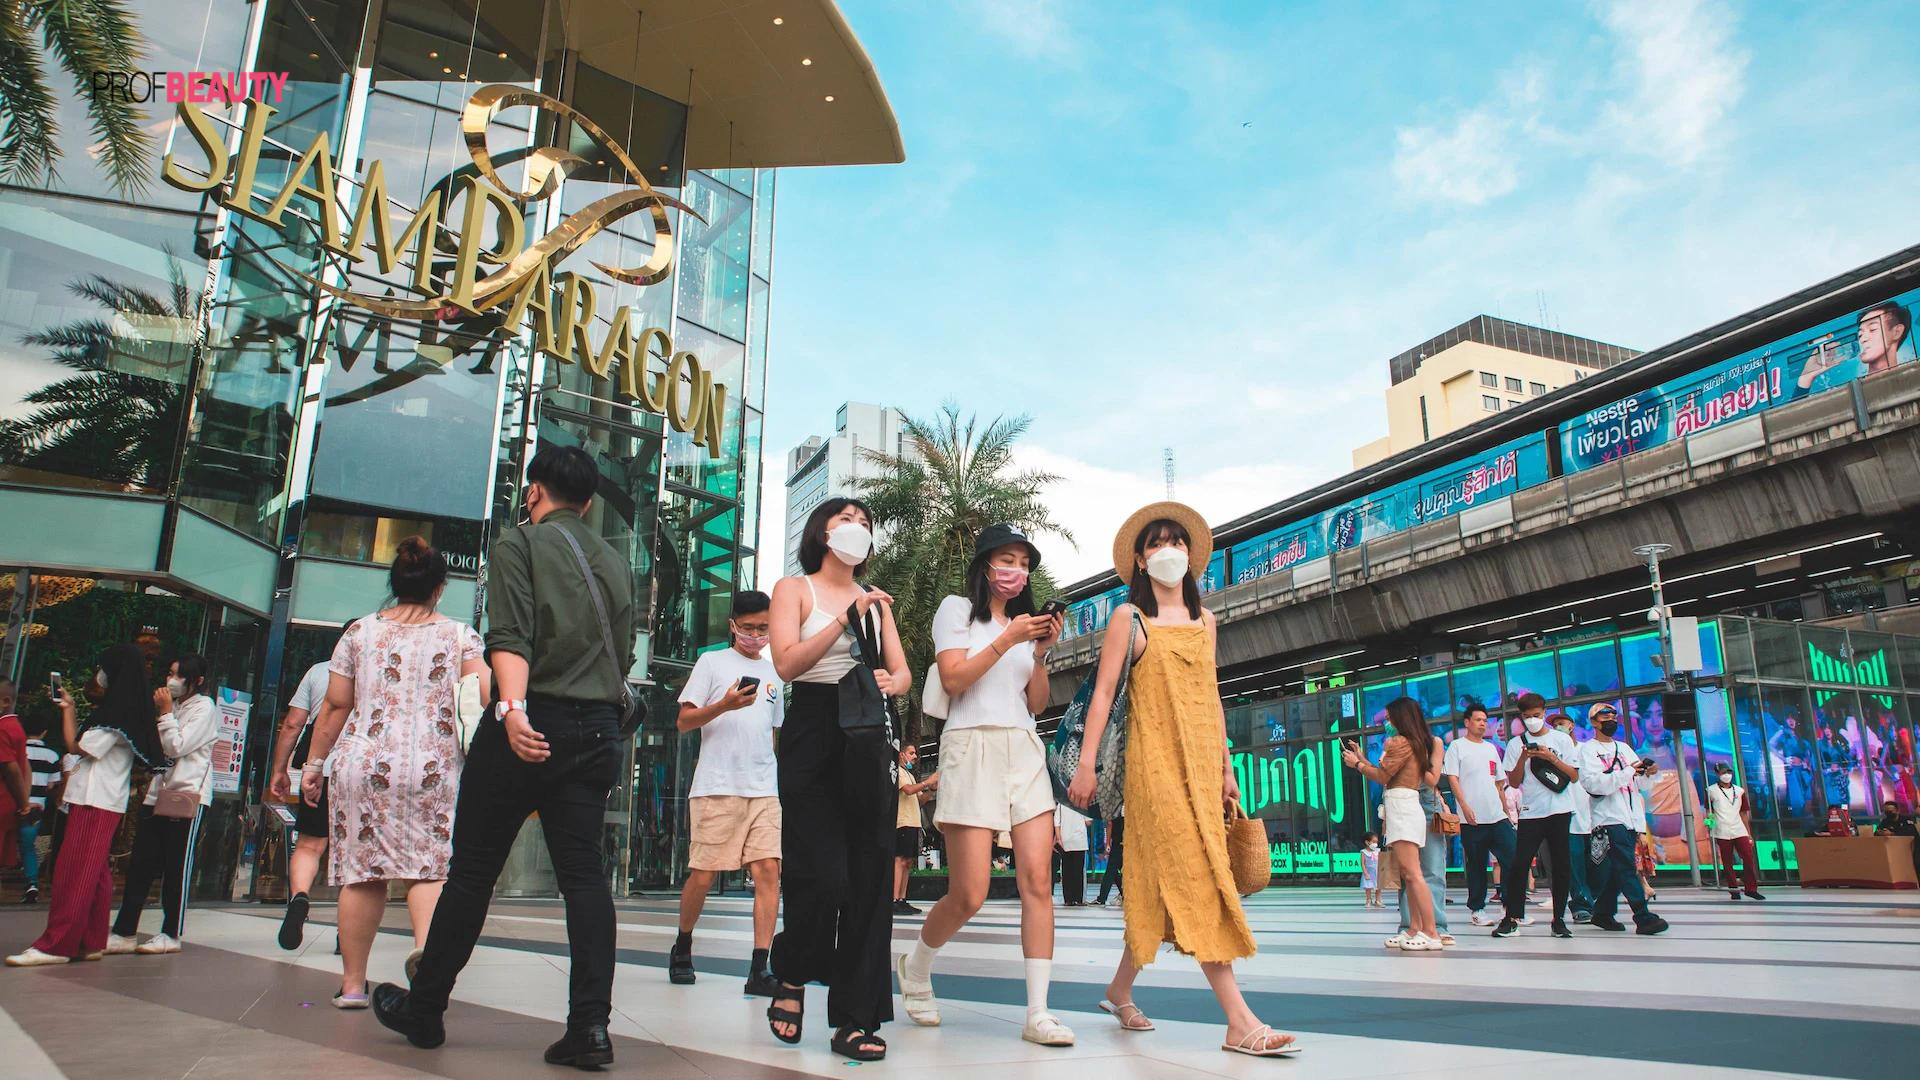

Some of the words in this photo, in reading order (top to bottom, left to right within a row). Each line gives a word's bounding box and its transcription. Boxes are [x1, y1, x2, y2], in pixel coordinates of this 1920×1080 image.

[160, 76, 442, 297] SIAM
[440, 174, 728, 459] PARAGON
[1300, 841, 1327, 854] NOW
[1339, 860, 1359, 868] TIDA
